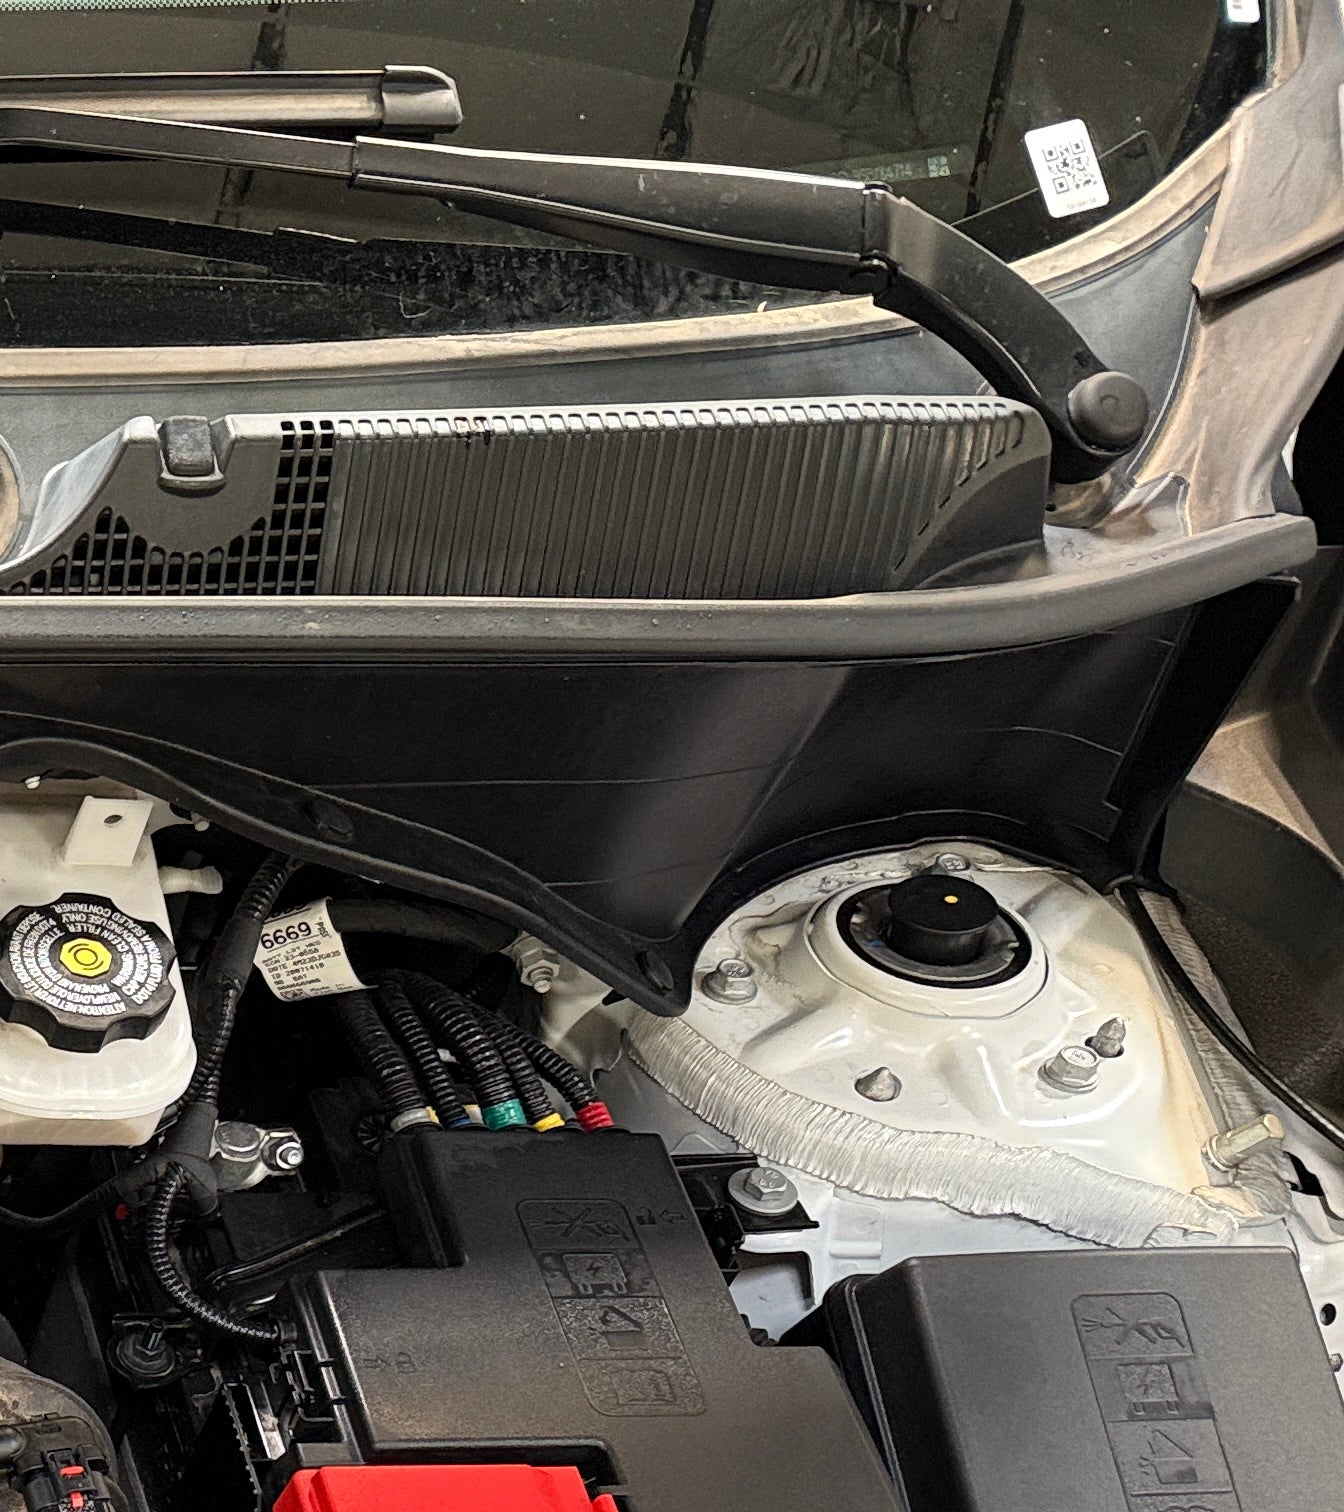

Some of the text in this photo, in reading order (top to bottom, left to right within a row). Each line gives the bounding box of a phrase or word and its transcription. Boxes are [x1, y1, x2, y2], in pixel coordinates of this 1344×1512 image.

[61, 913, 87, 923] ONLY
[87, 914, 109, 927] USE
[111, 912, 147, 936] SEALED
[68, 923, 101, 937] FILLER
[101, 930, 129, 953] CLEAN
[108, 920, 145, 954] REMOVING
[261, 921, 312, 949] 6669
